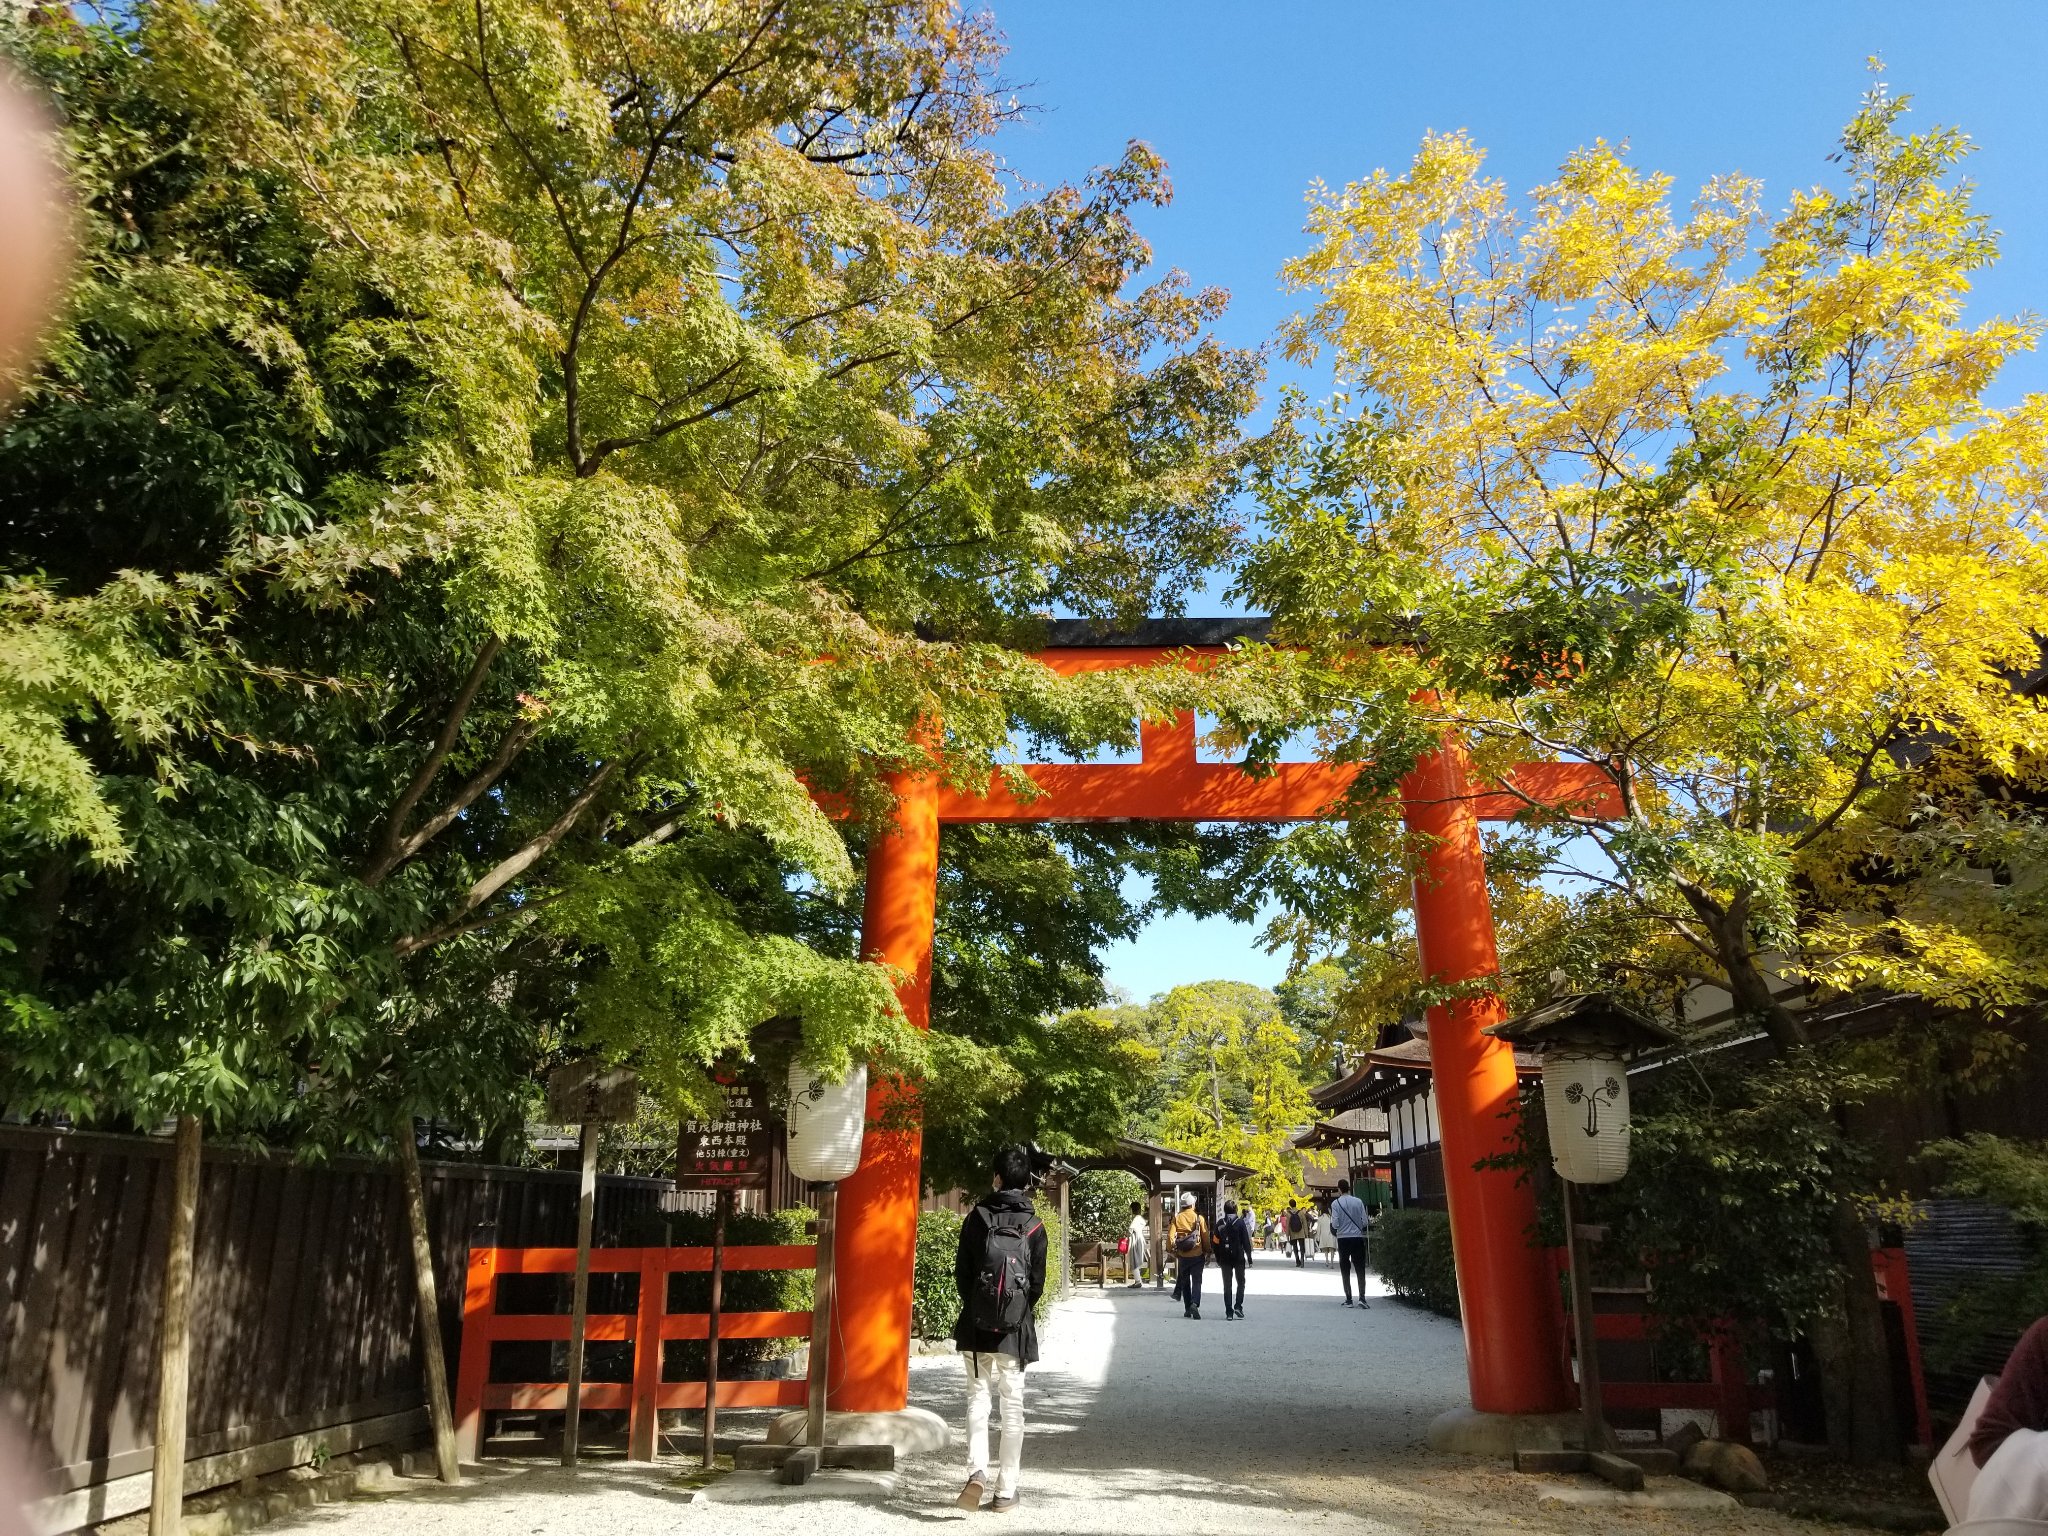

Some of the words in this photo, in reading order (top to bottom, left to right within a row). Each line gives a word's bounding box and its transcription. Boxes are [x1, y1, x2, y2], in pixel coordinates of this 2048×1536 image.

[686, 1119, 763, 1134] 賀茂御祖神社
[698, 1135, 747, 1147] 東西本殿
